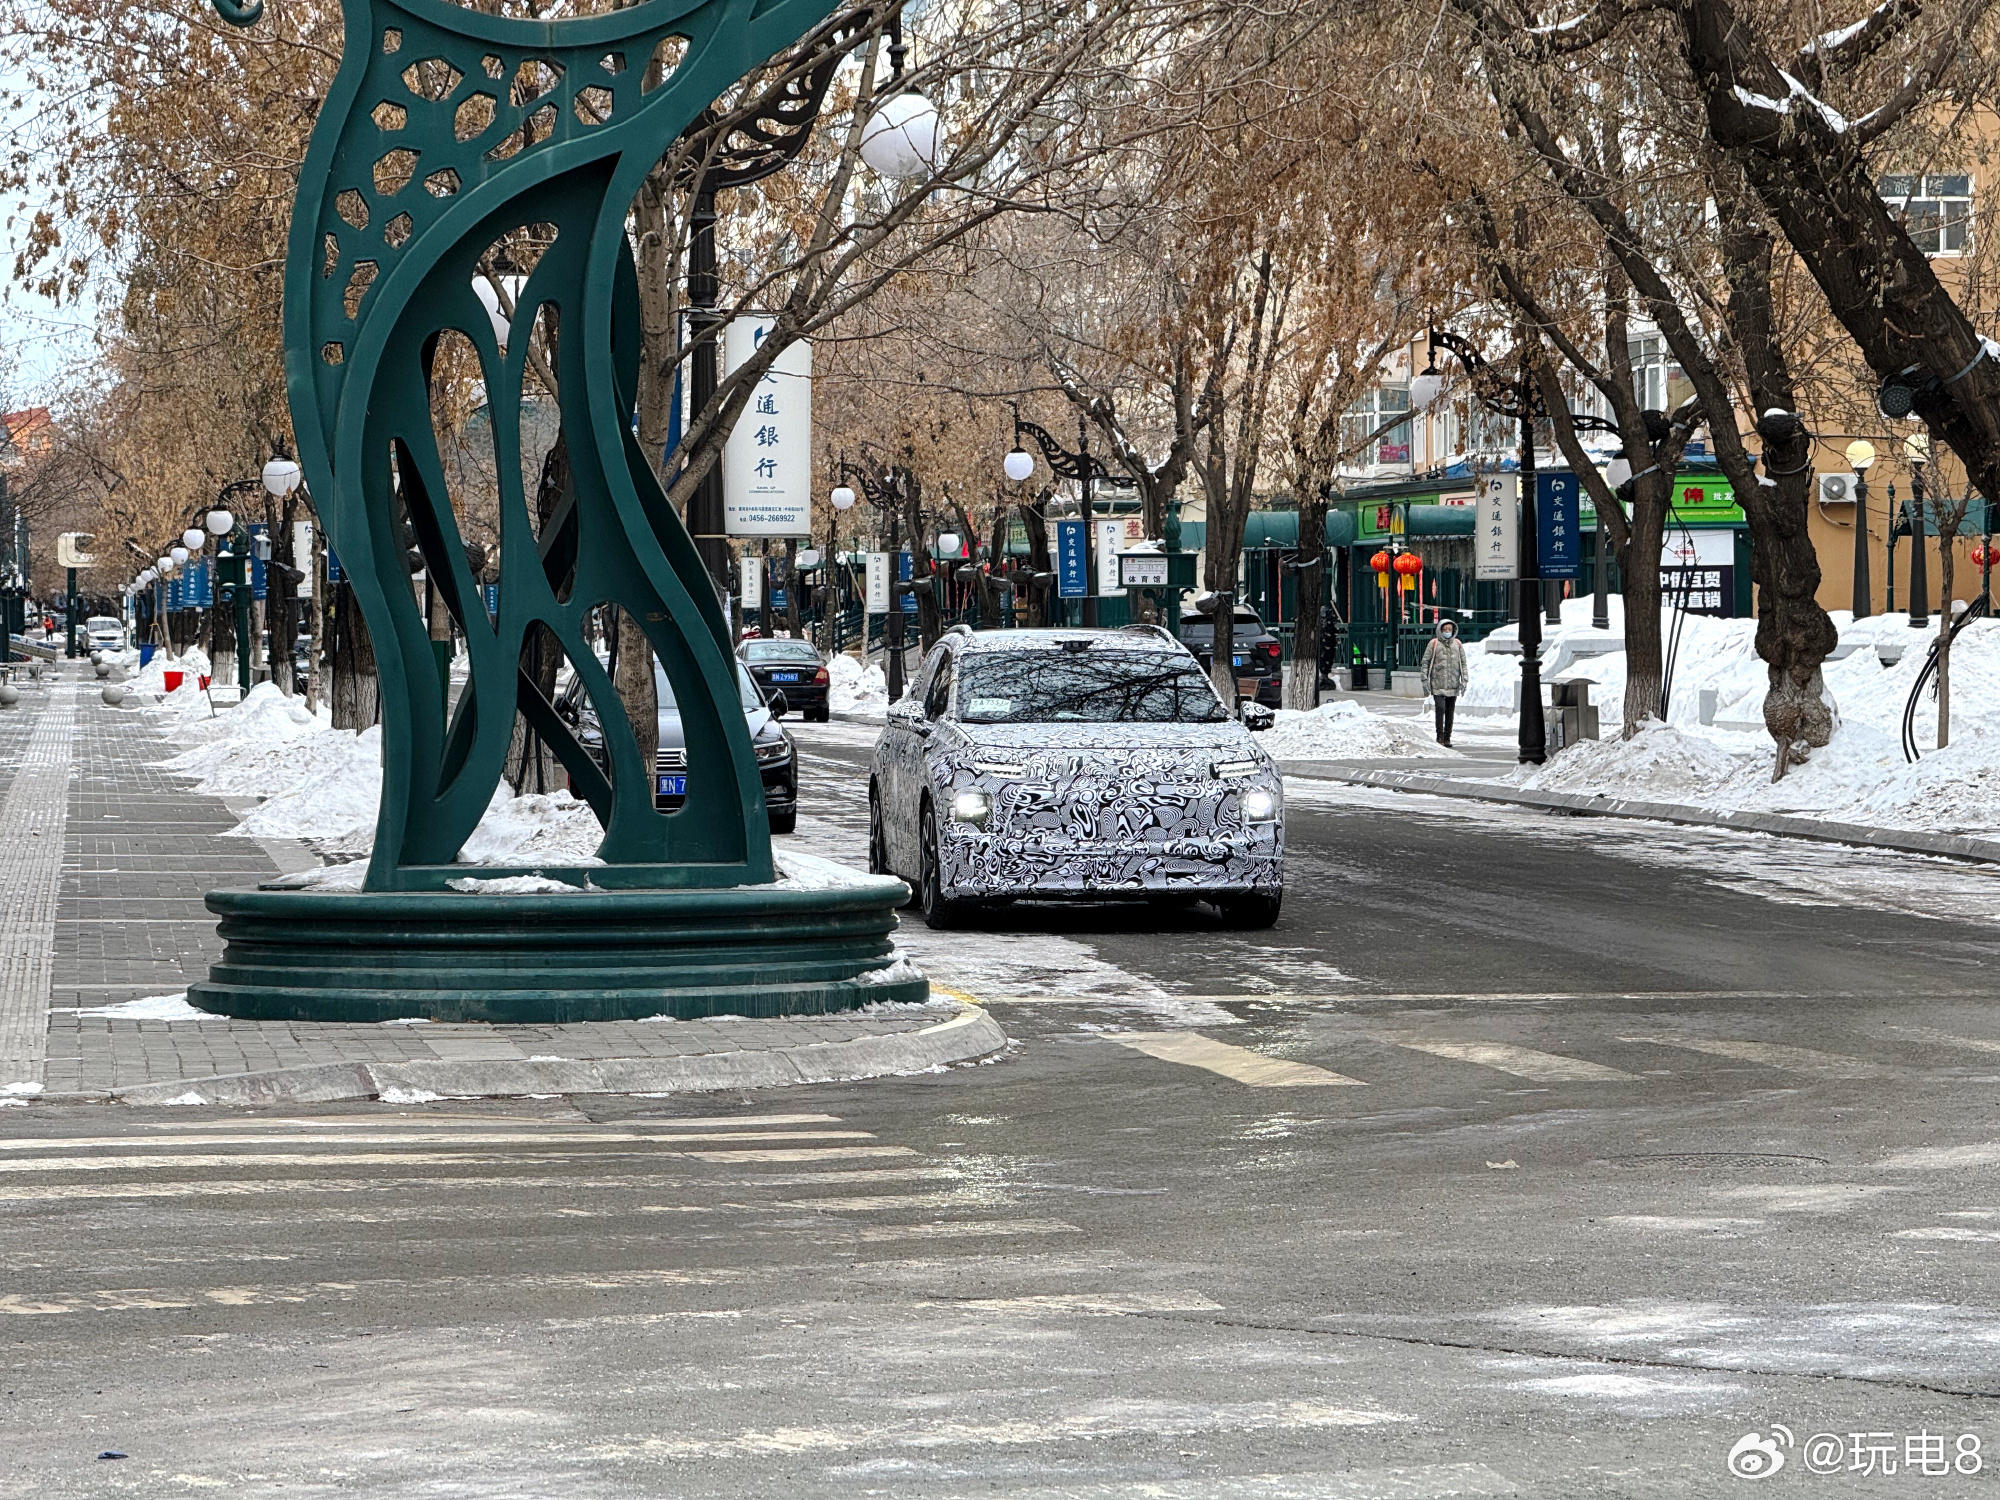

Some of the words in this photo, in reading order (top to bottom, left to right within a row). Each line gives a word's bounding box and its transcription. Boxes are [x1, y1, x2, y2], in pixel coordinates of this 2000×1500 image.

[748, 514, 795, 522] 0456-2669922
[1127, 520, 1140, 537] 老
[1490, 496, 1503, 552] 交通銀行
[1552, 496, 1565, 552] 交通銀行
[1068, 538, 1077, 578] 交通銀行
[1128, 575, 1161, 584] 体育馆
